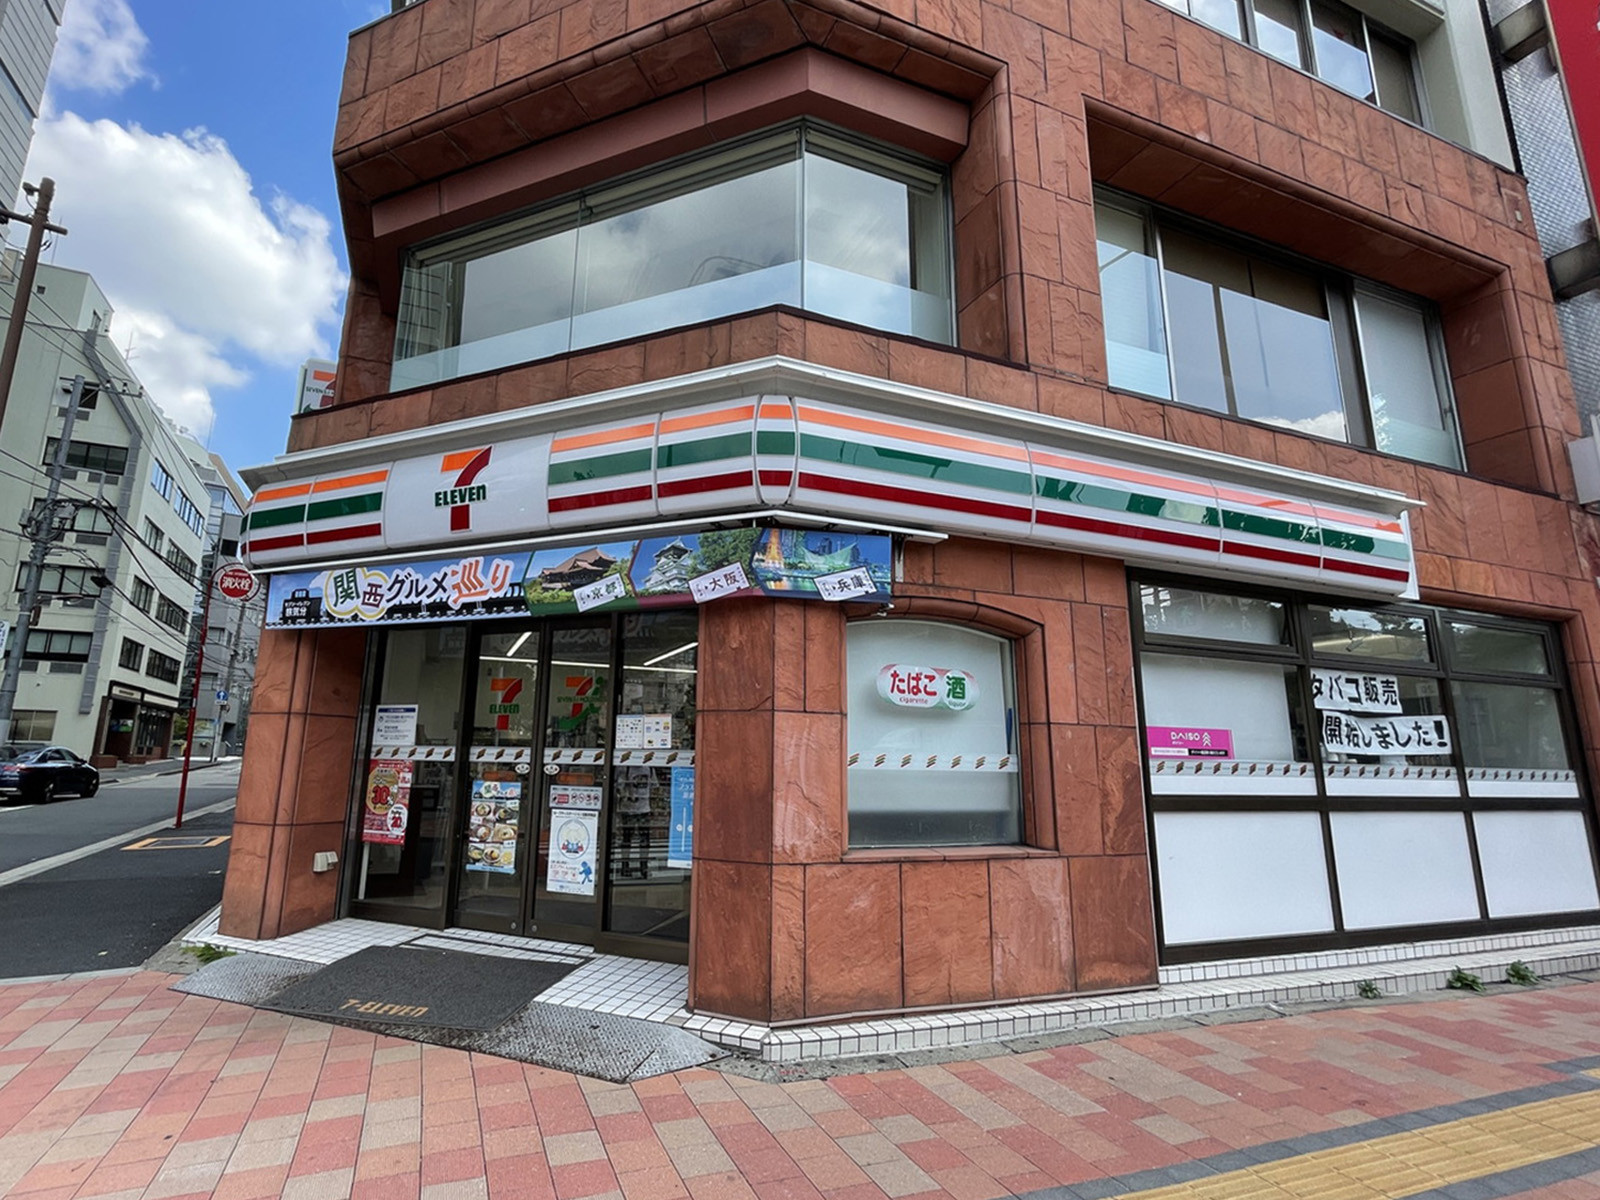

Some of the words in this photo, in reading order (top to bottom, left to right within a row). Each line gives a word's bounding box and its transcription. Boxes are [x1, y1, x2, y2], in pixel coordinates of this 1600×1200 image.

[441, 446, 492, 531] 7
[333, 559, 510, 608] 関西グルメ巡り
[891, 669, 937, 696] たばこ
[946, 675, 966, 699] 酒
[1312, 674, 1398, 706] タバコ販売
